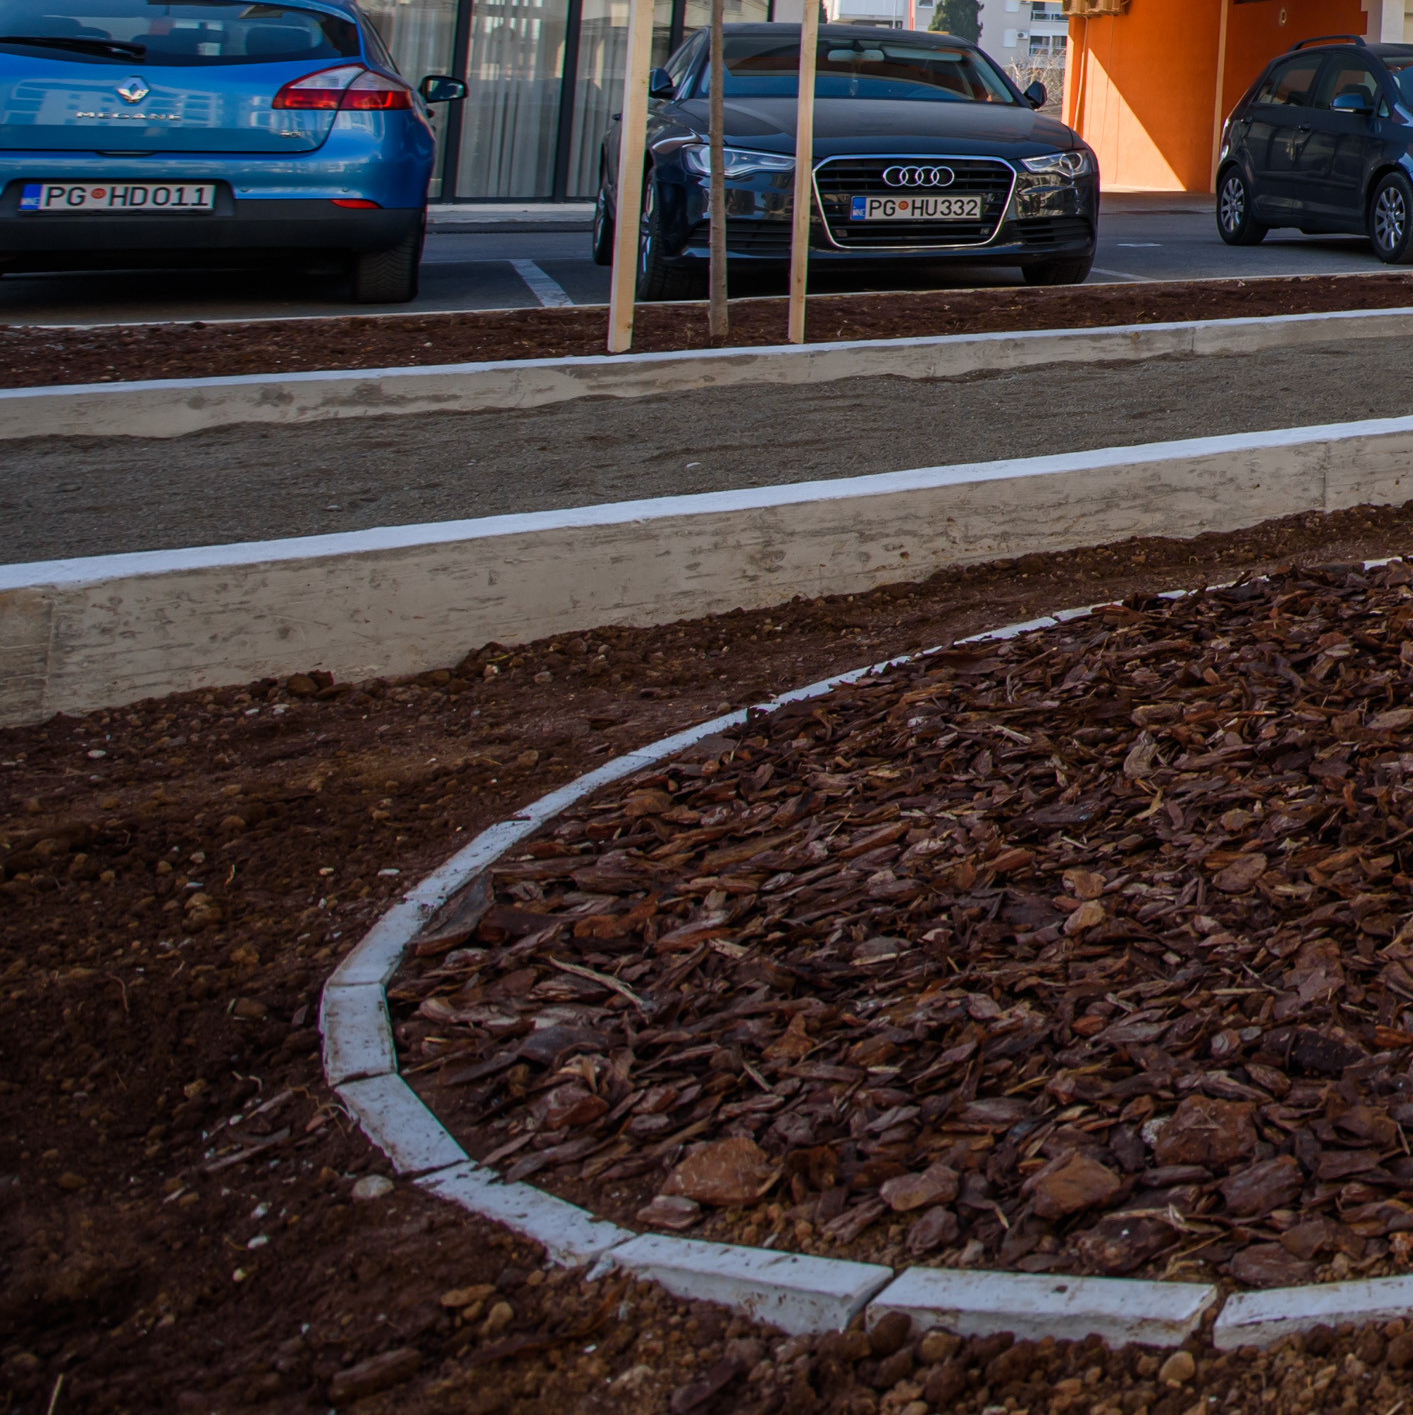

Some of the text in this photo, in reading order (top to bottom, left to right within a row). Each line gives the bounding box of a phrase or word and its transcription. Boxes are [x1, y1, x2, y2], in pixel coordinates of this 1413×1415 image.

[76, 111, 181, 121] MEGANE
[45, 186, 209, 207] PG HD011
[869, 199, 978, 217] PG HU332
